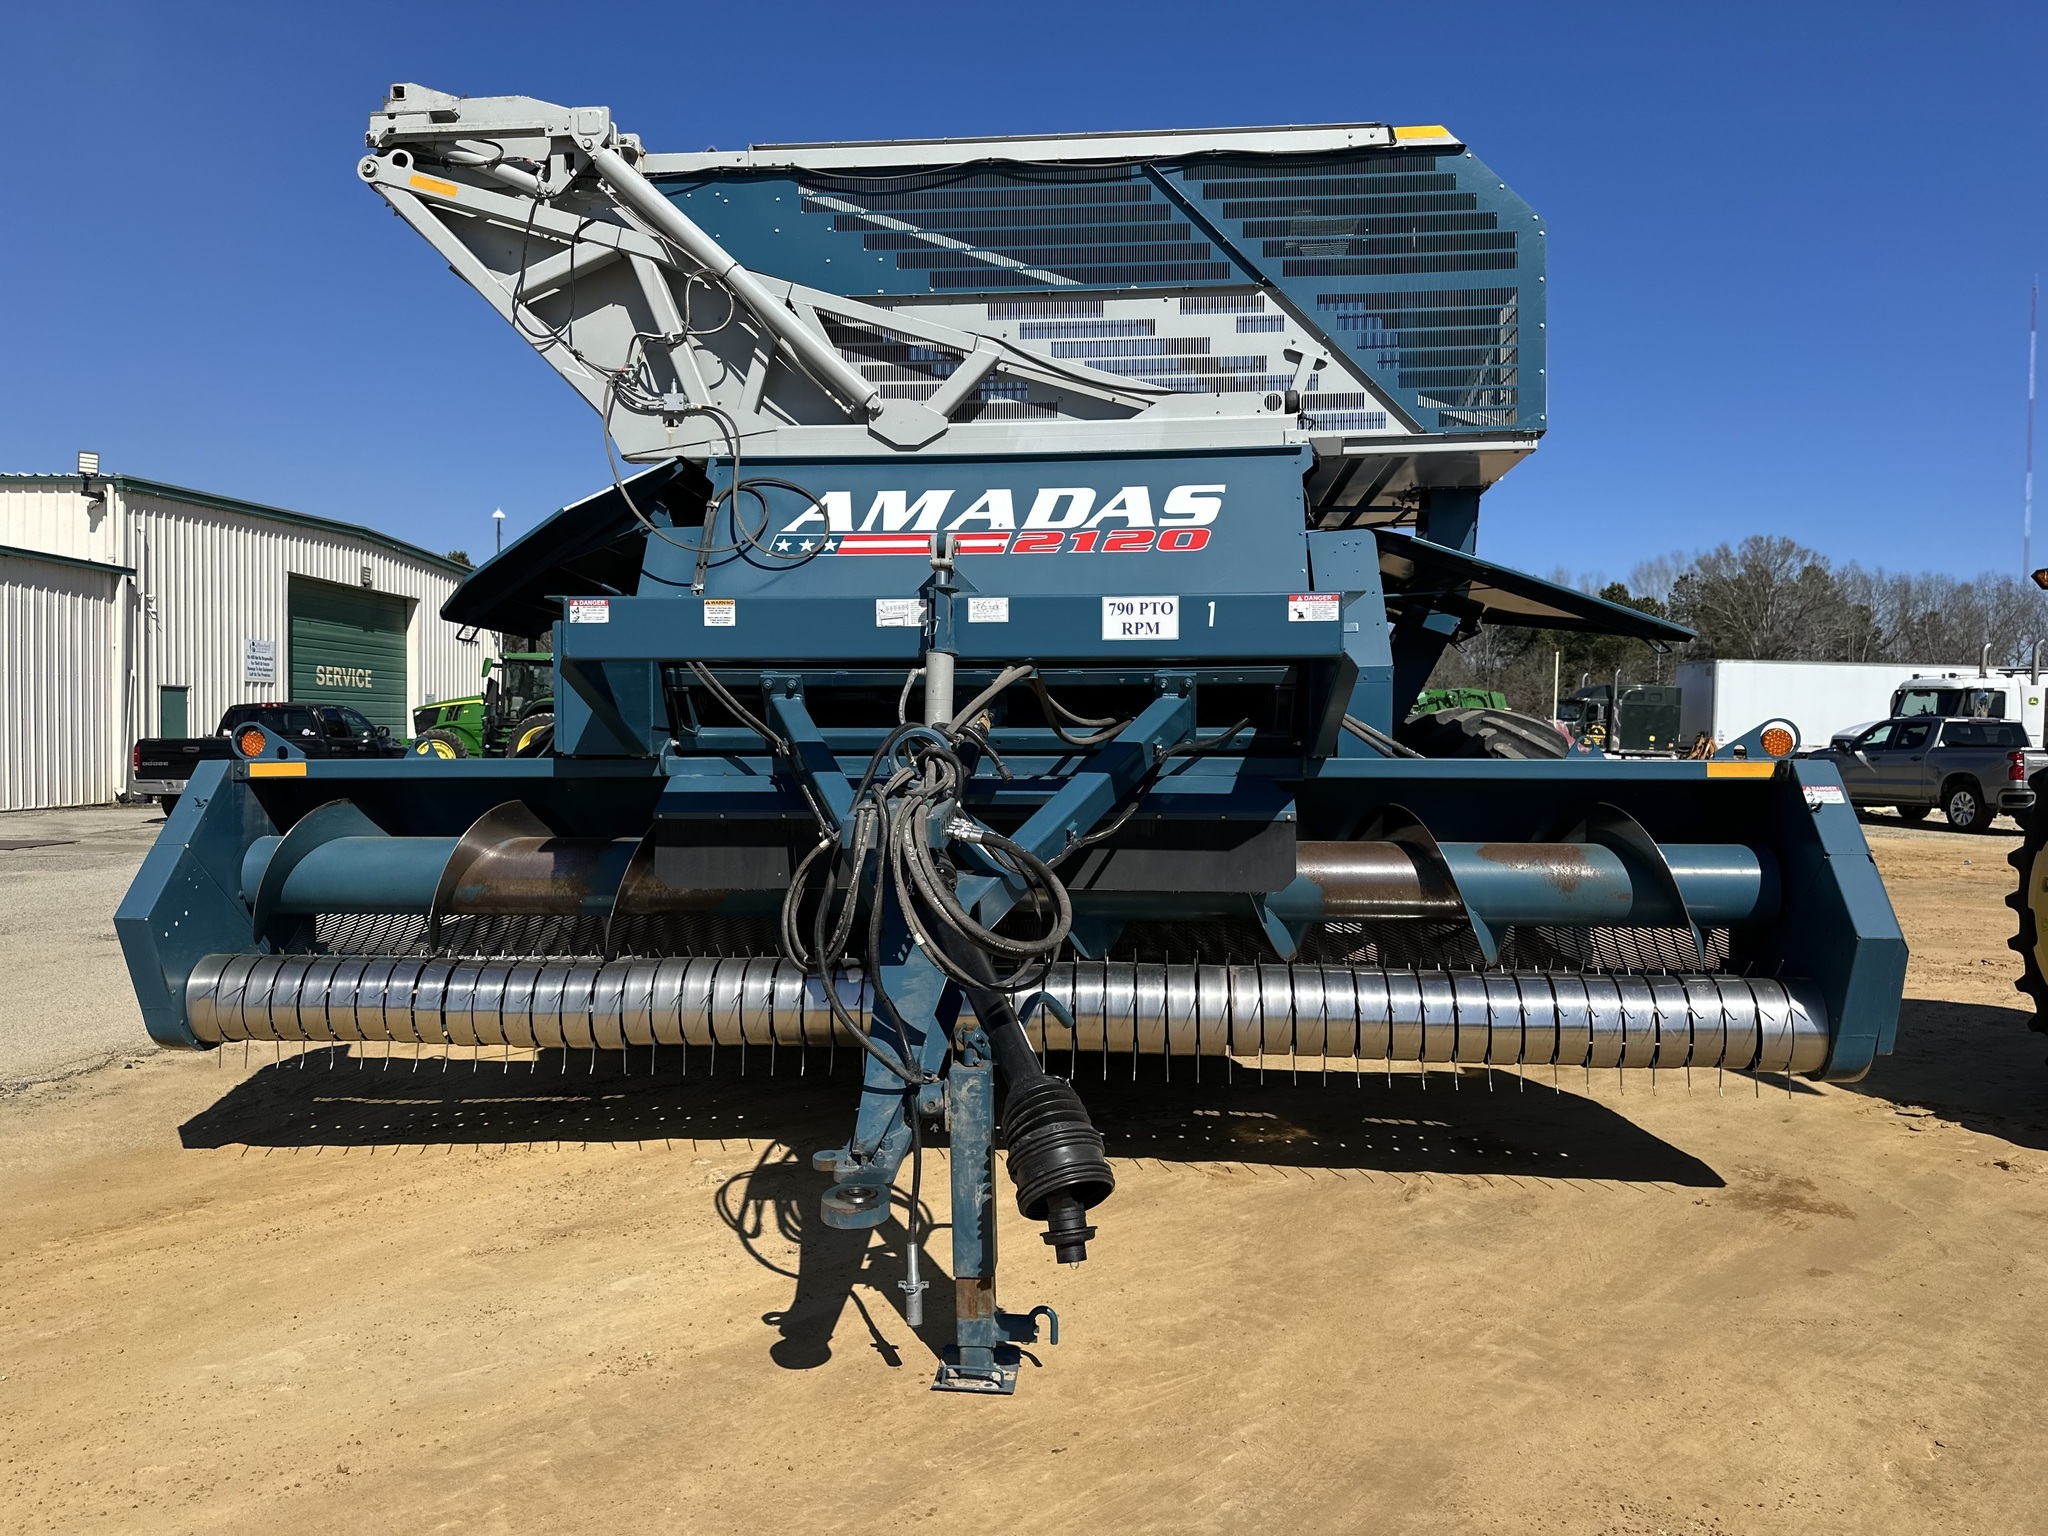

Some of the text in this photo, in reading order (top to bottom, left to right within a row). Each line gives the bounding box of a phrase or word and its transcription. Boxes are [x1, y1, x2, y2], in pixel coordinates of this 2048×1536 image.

[780, 484, 1227, 532] AMADAS
[1009, 528, 1212, 554] 2120
[1108, 601, 1174, 616] 790 PTO
[1207, 601, 1216, 628] 1
[1121, 622, 1161, 635] RPM
[316, 665, 373, 689] SERVICE
